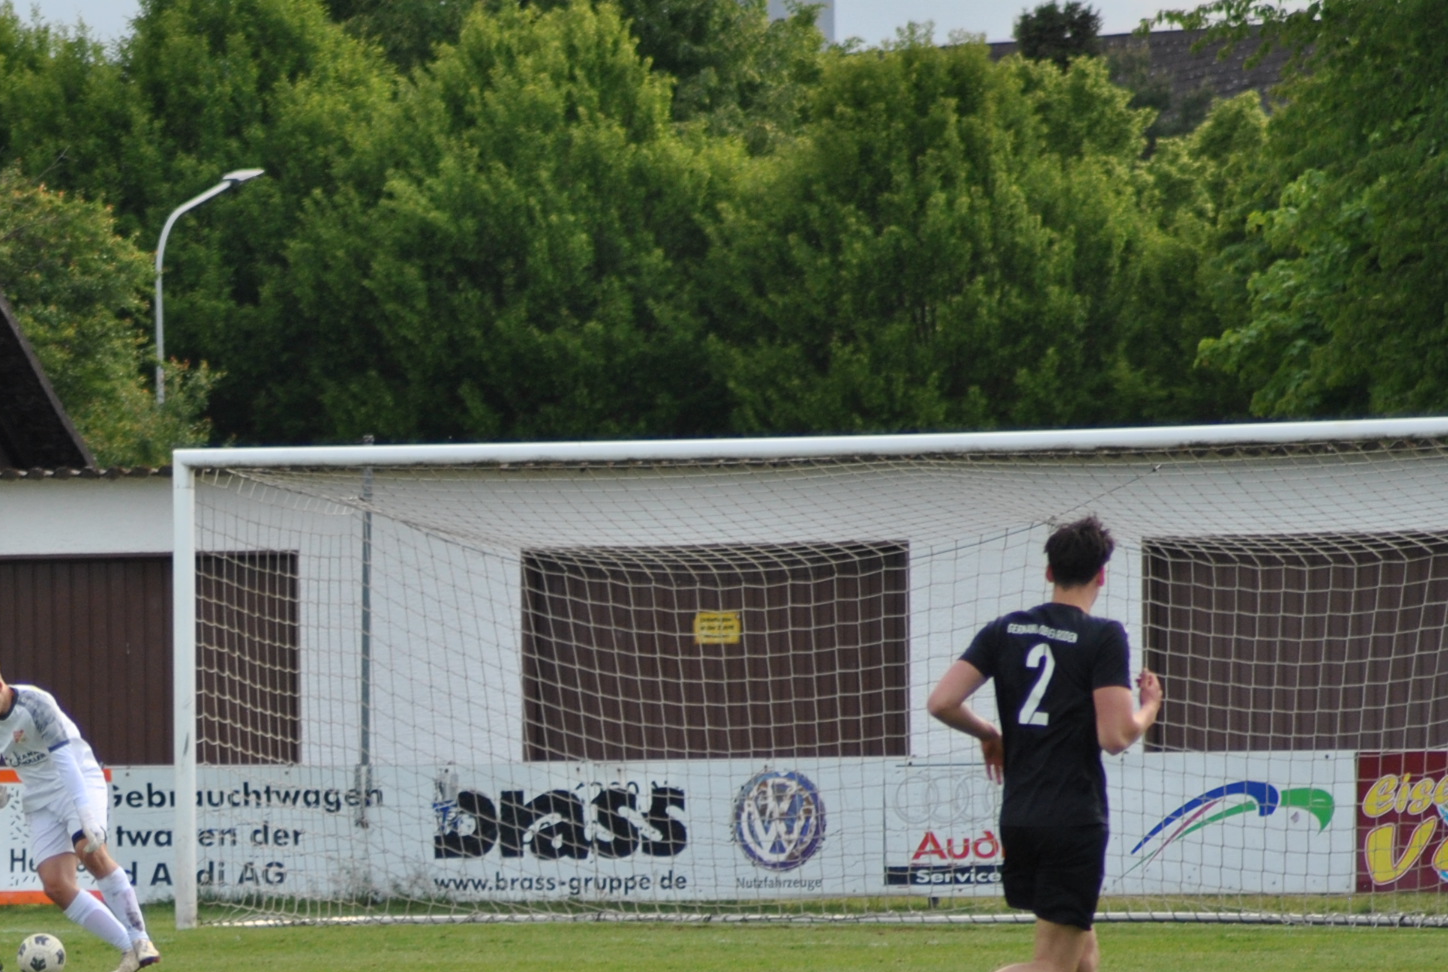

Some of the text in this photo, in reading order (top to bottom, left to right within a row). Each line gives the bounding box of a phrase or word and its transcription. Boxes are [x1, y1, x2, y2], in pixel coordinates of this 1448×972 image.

[1018, 643, 1055, 726] 2
[250, 820, 306, 847] der
[150, 860, 214, 886] Adi
[238, 861, 288, 886] AG
[736, 876, 823, 891] Nutzfahrzeuge
[916, 868, 1002, 884] Service
